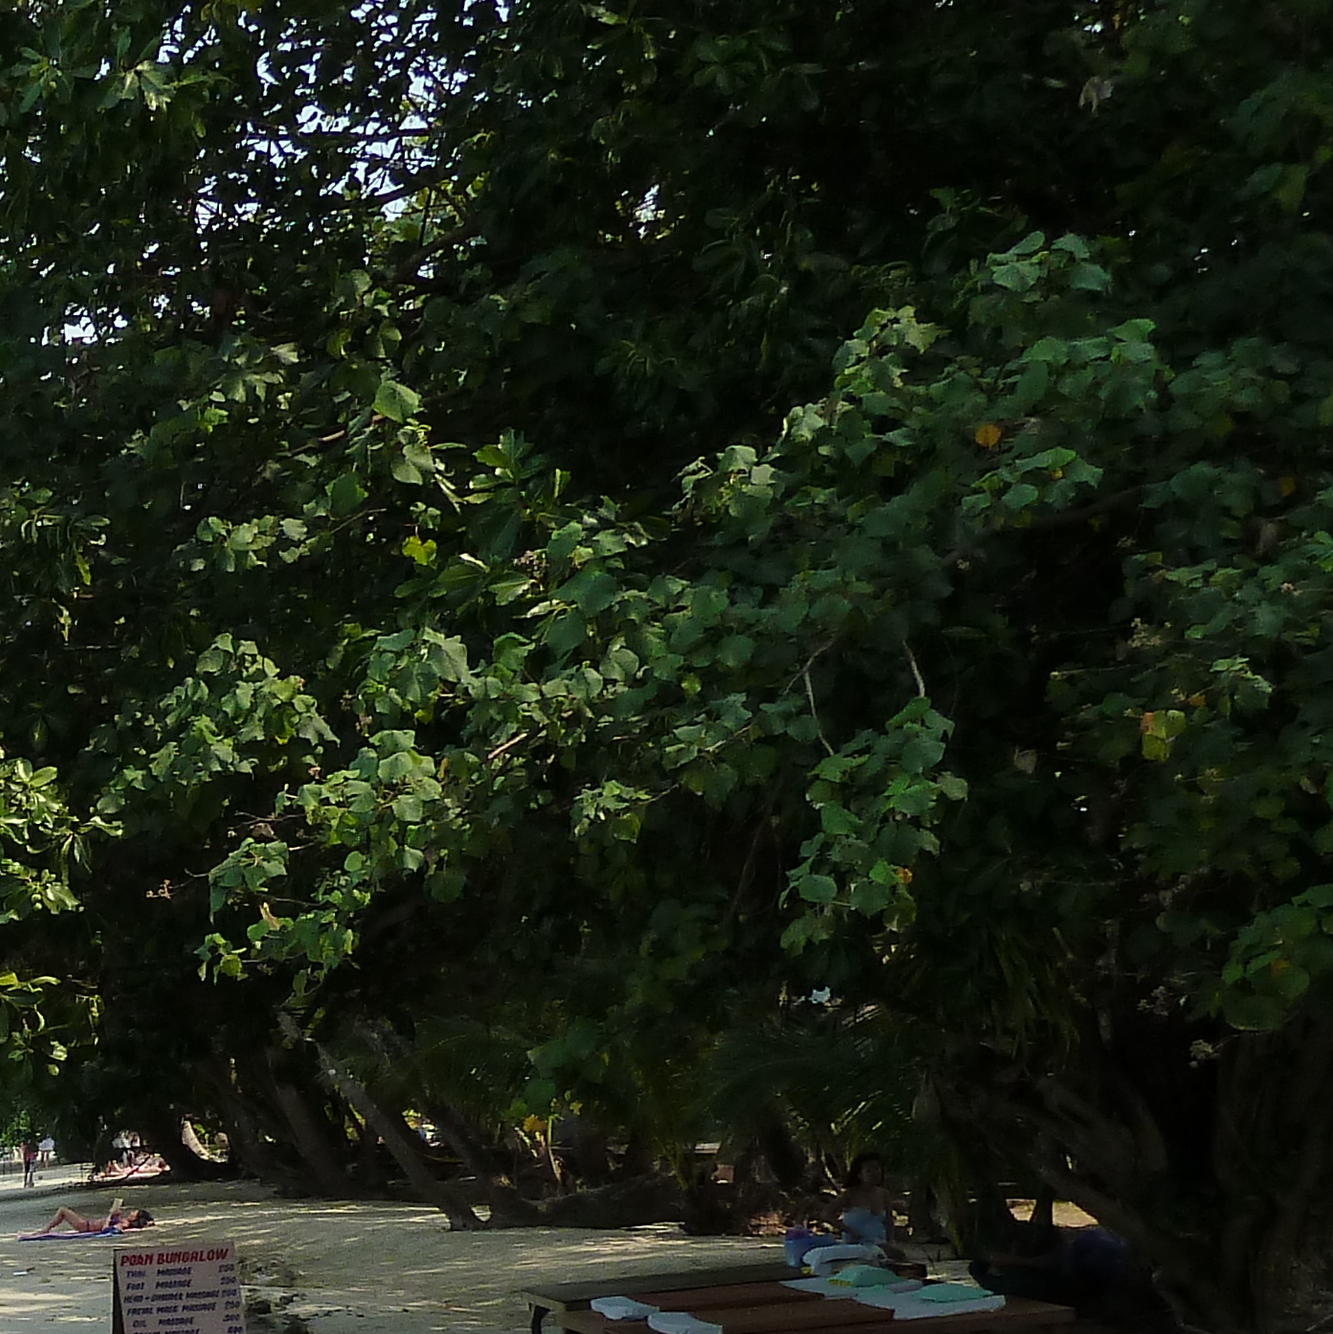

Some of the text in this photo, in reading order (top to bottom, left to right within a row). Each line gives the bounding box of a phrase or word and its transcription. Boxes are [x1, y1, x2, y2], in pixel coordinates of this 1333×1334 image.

[156, 1248, 229, 1265] BUNGALOW
[156, 1267, 192, 1277] MASSAGE
[126, 1282, 145, 1290] FOOT
[155, 1279, 192, 1289] MASSAGE
[123, 1295, 144, 1303] HEAD
[185, 1289, 219, 1299] MASSAGE
[182, 1302, 217, 1312] MASSAGE
[132, 1320, 147, 1328] OIL
[158, 1316, 195, 1326] MASSAGE
